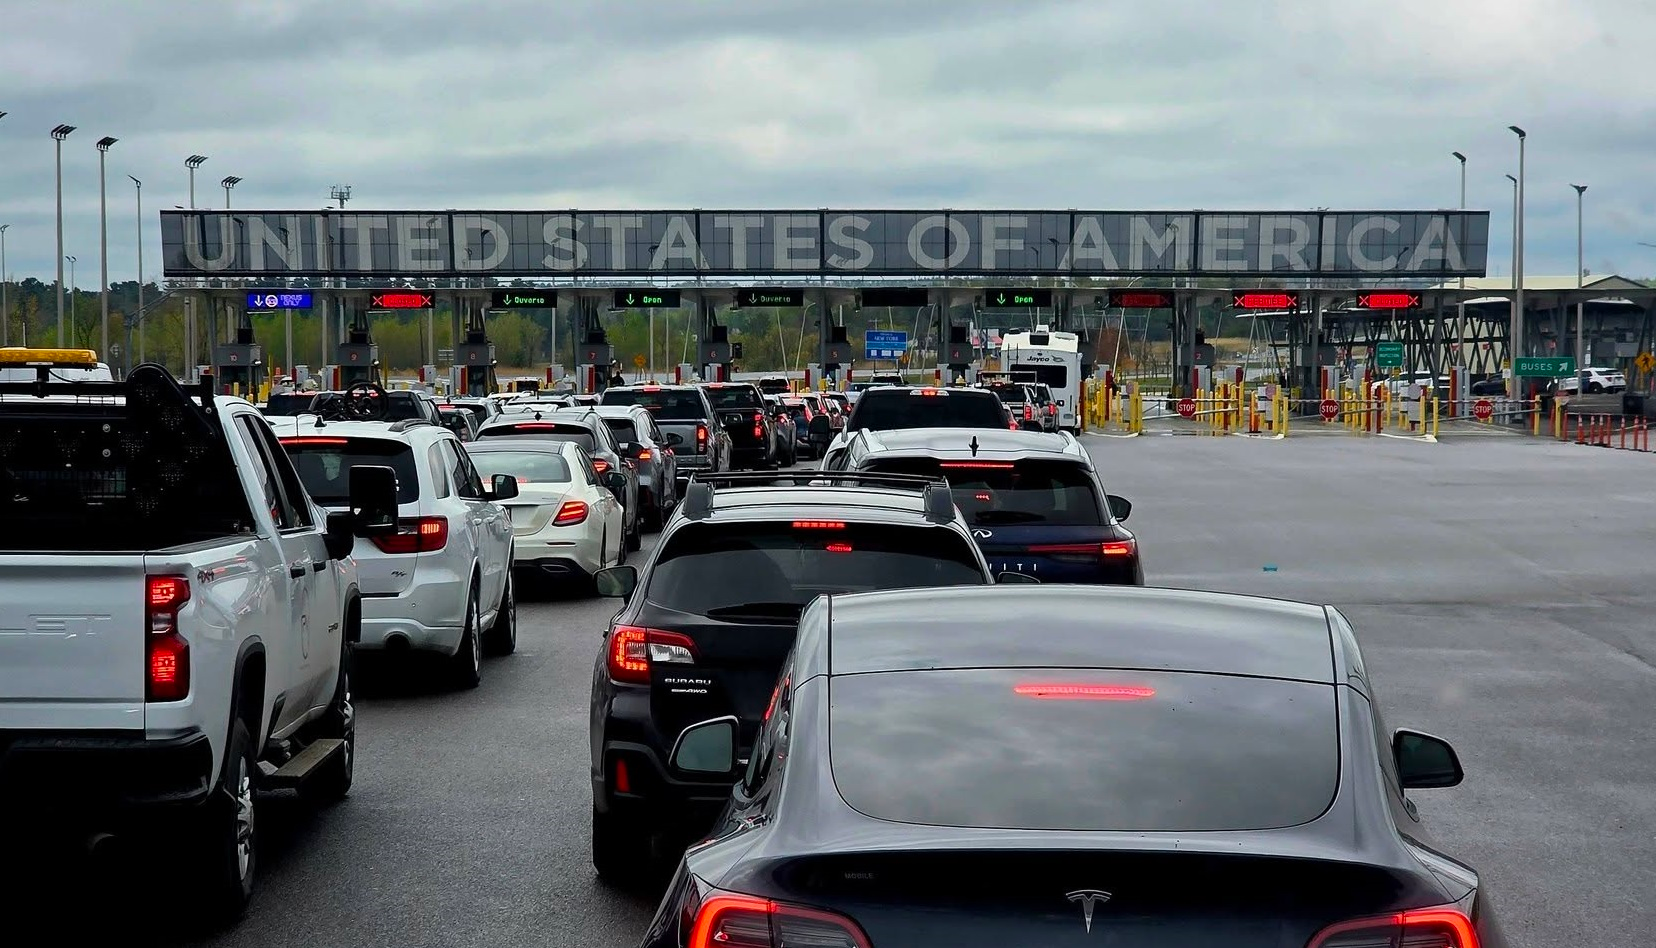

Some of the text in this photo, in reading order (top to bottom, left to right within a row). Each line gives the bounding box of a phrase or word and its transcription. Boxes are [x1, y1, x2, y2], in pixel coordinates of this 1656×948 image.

[184, 215, 1467, 271] UNITED STATES OF AMERICA
[643, 296, 662, 304] Open
[1014, 295, 1034, 303] Open
[1026, 355, 1050, 363] Jayco
[1521, 362, 1553, 371] BUSES
[1321, 405, 1338, 413] STOP
[664, 677, 711, 685] SUBARU
